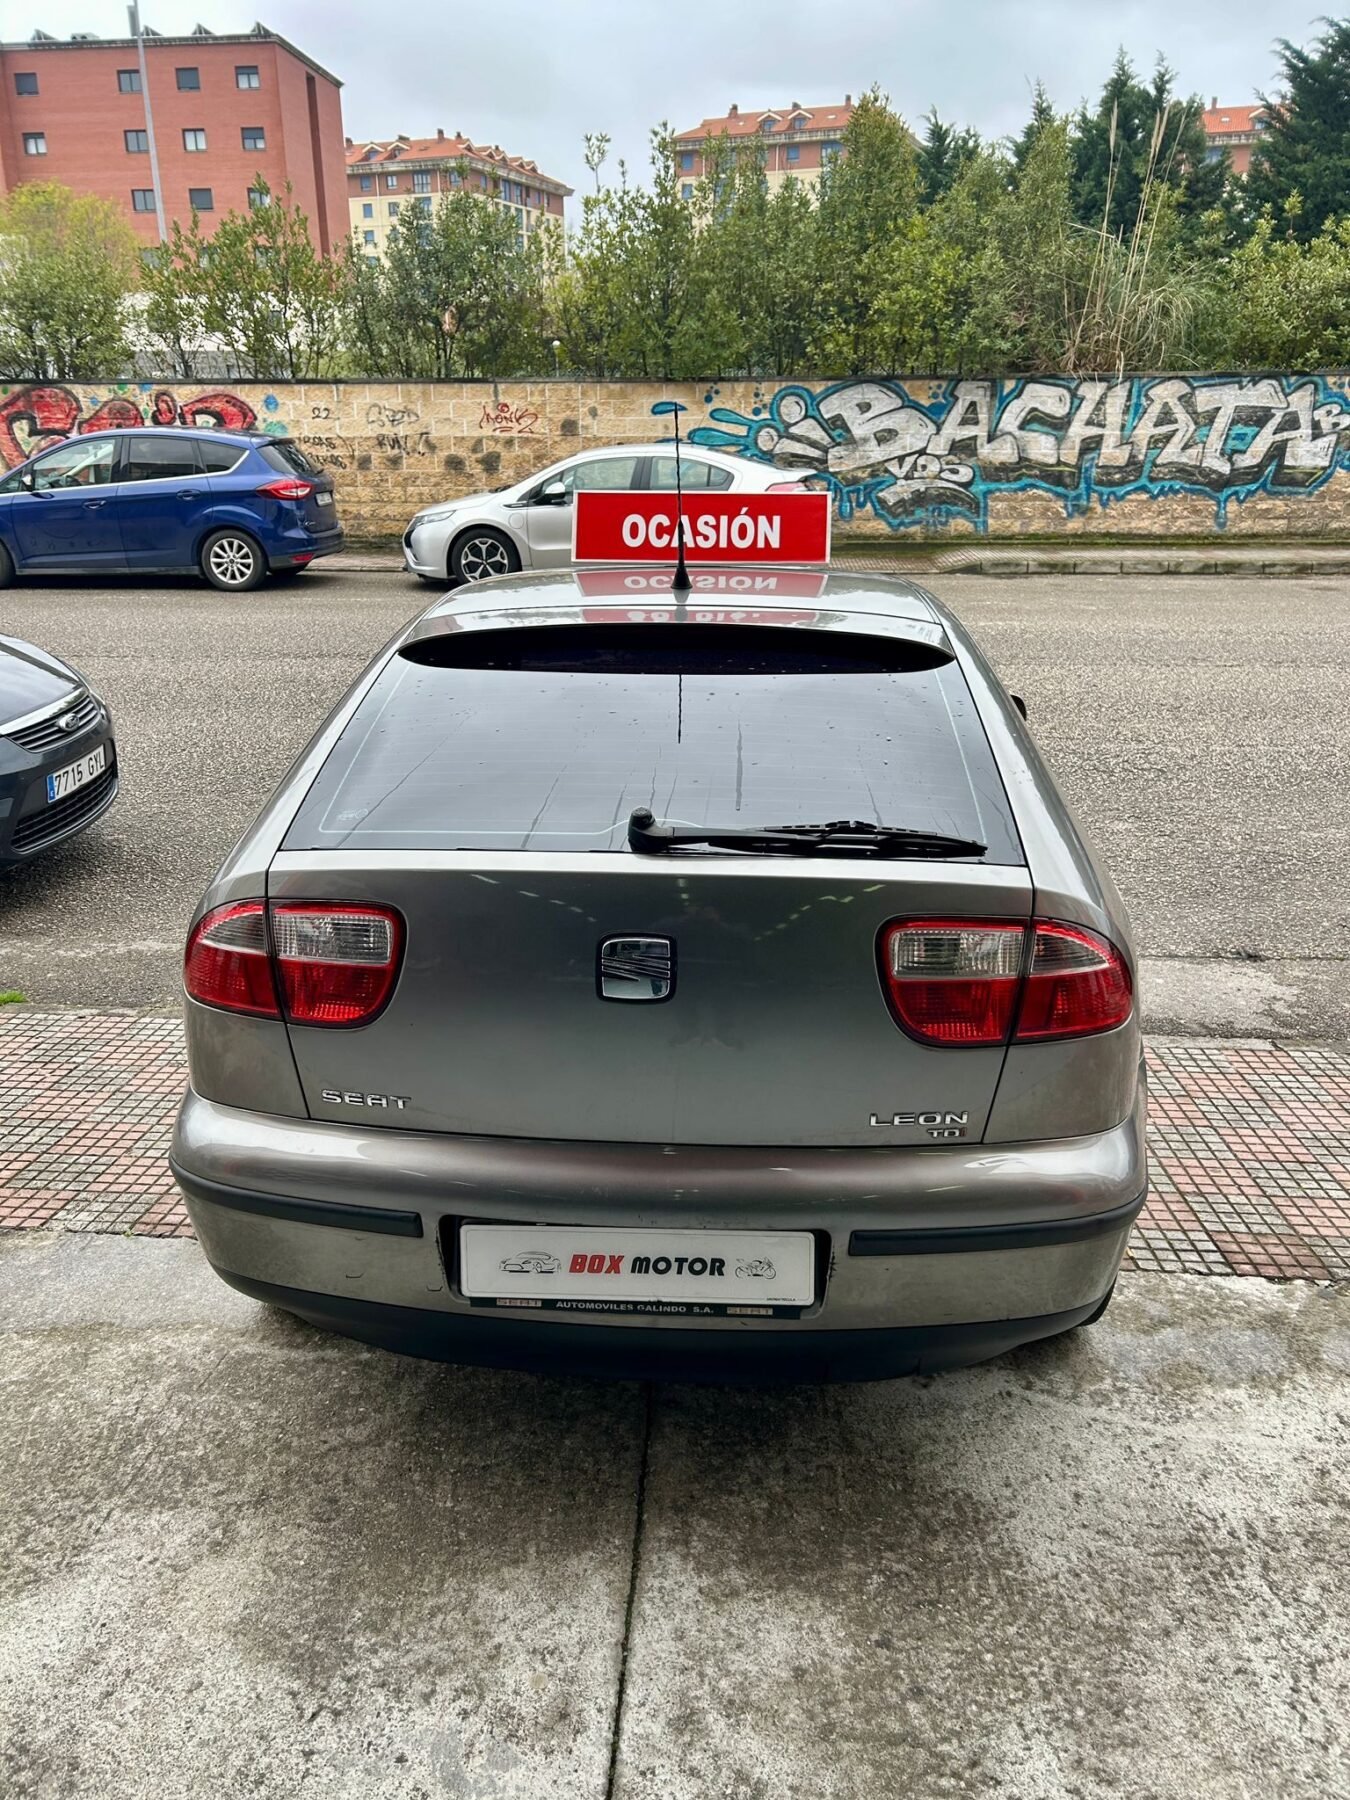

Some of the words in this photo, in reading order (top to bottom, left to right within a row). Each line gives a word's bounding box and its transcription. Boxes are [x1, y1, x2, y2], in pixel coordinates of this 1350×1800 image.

[621, 507, 781, 549] OCASIÓN
[54, 763, 83, 796] 7715
[87, 751, 104, 776] GYL
[321, 1089, 411, 1109] SEAT
[869, 1111, 968, 1126] LEON
[569, 1254, 624, 1274] BOX
[630, 1256, 726, 1276] MOTOR
[556, 1300, 633, 1311] AUTOMOVILES
[637, 1304, 686, 1313] GALINDO
